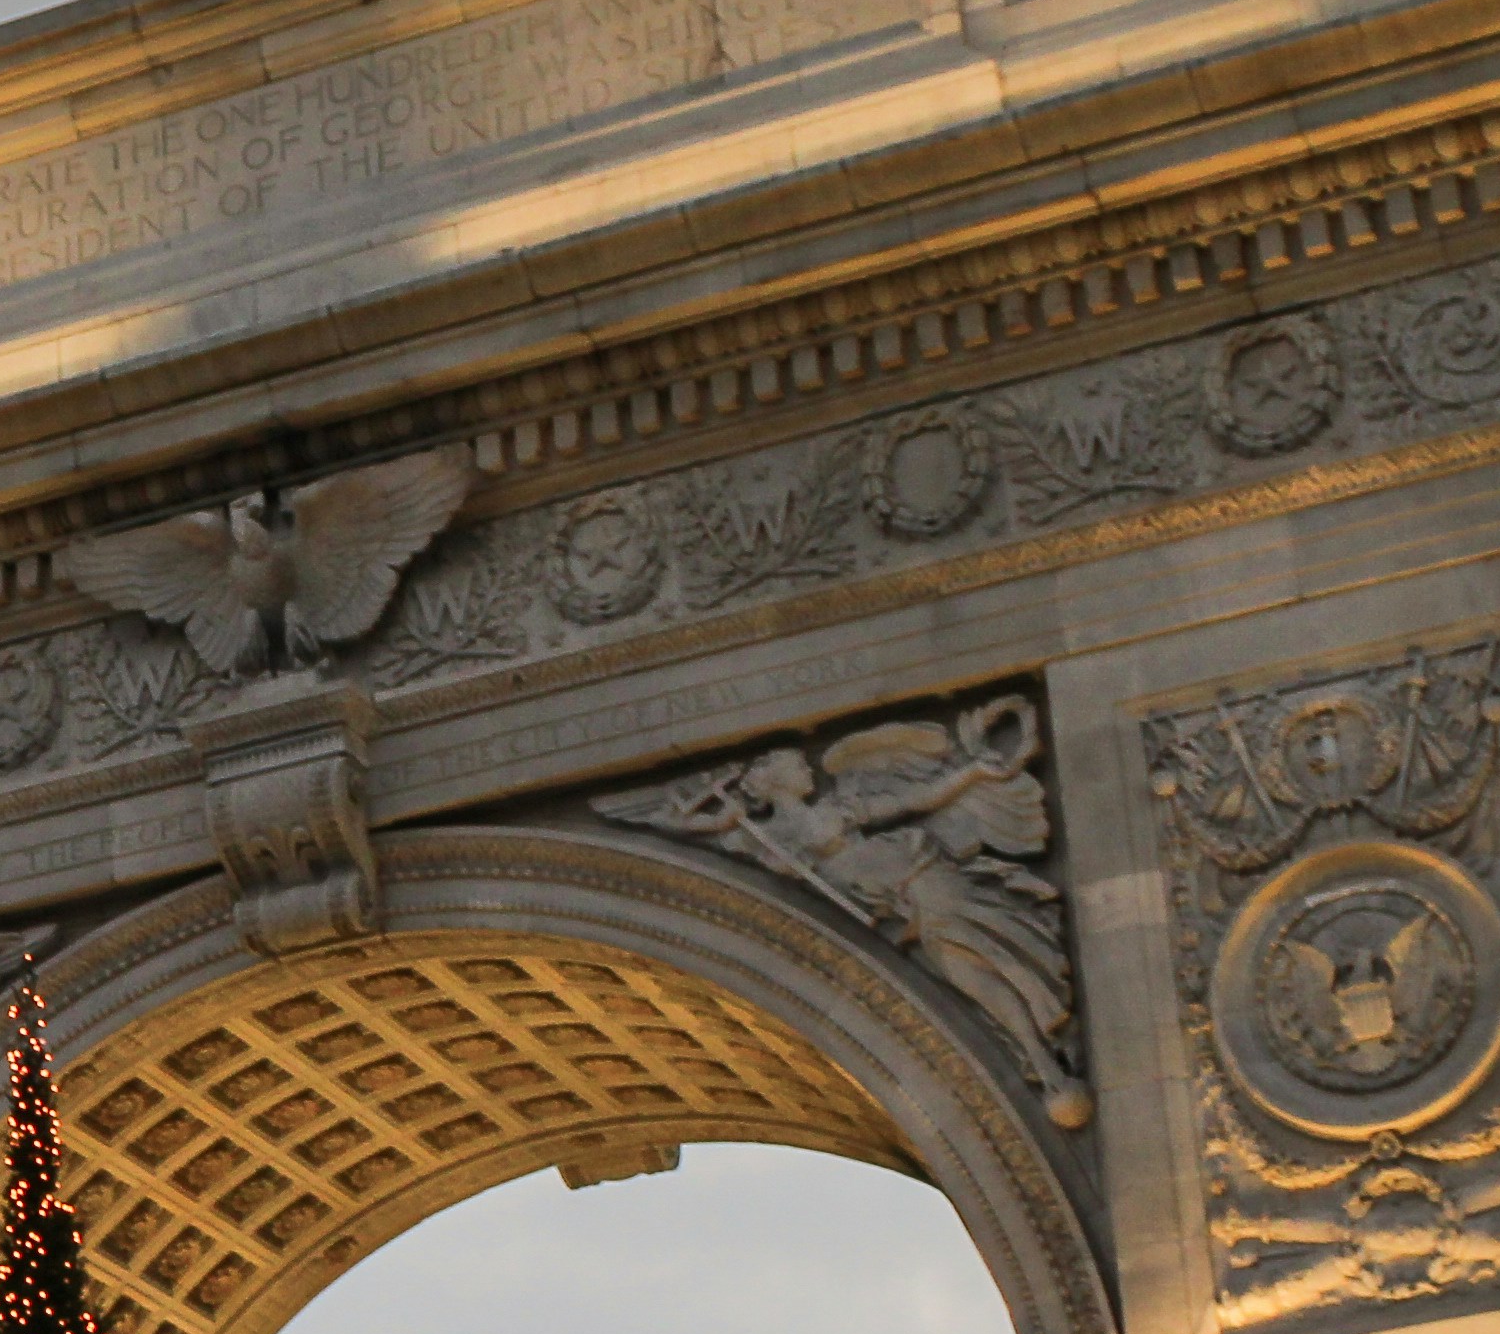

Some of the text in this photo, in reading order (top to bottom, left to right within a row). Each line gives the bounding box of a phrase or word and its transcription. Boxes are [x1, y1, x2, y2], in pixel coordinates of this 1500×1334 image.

[105, 119, 187, 171] THE
[195, 93, 284, 143] ONE
[296, 13, 564, 114] HUNDREDTH
[217, 171, 280, 218] OF
[308, 139, 403, 193] THE
[427, 78, 610, 157] UNITED
[241, 124, 303, 171] OF
[319, 70, 506, 148] GEORGE
[23, 838, 87, 872] THE
